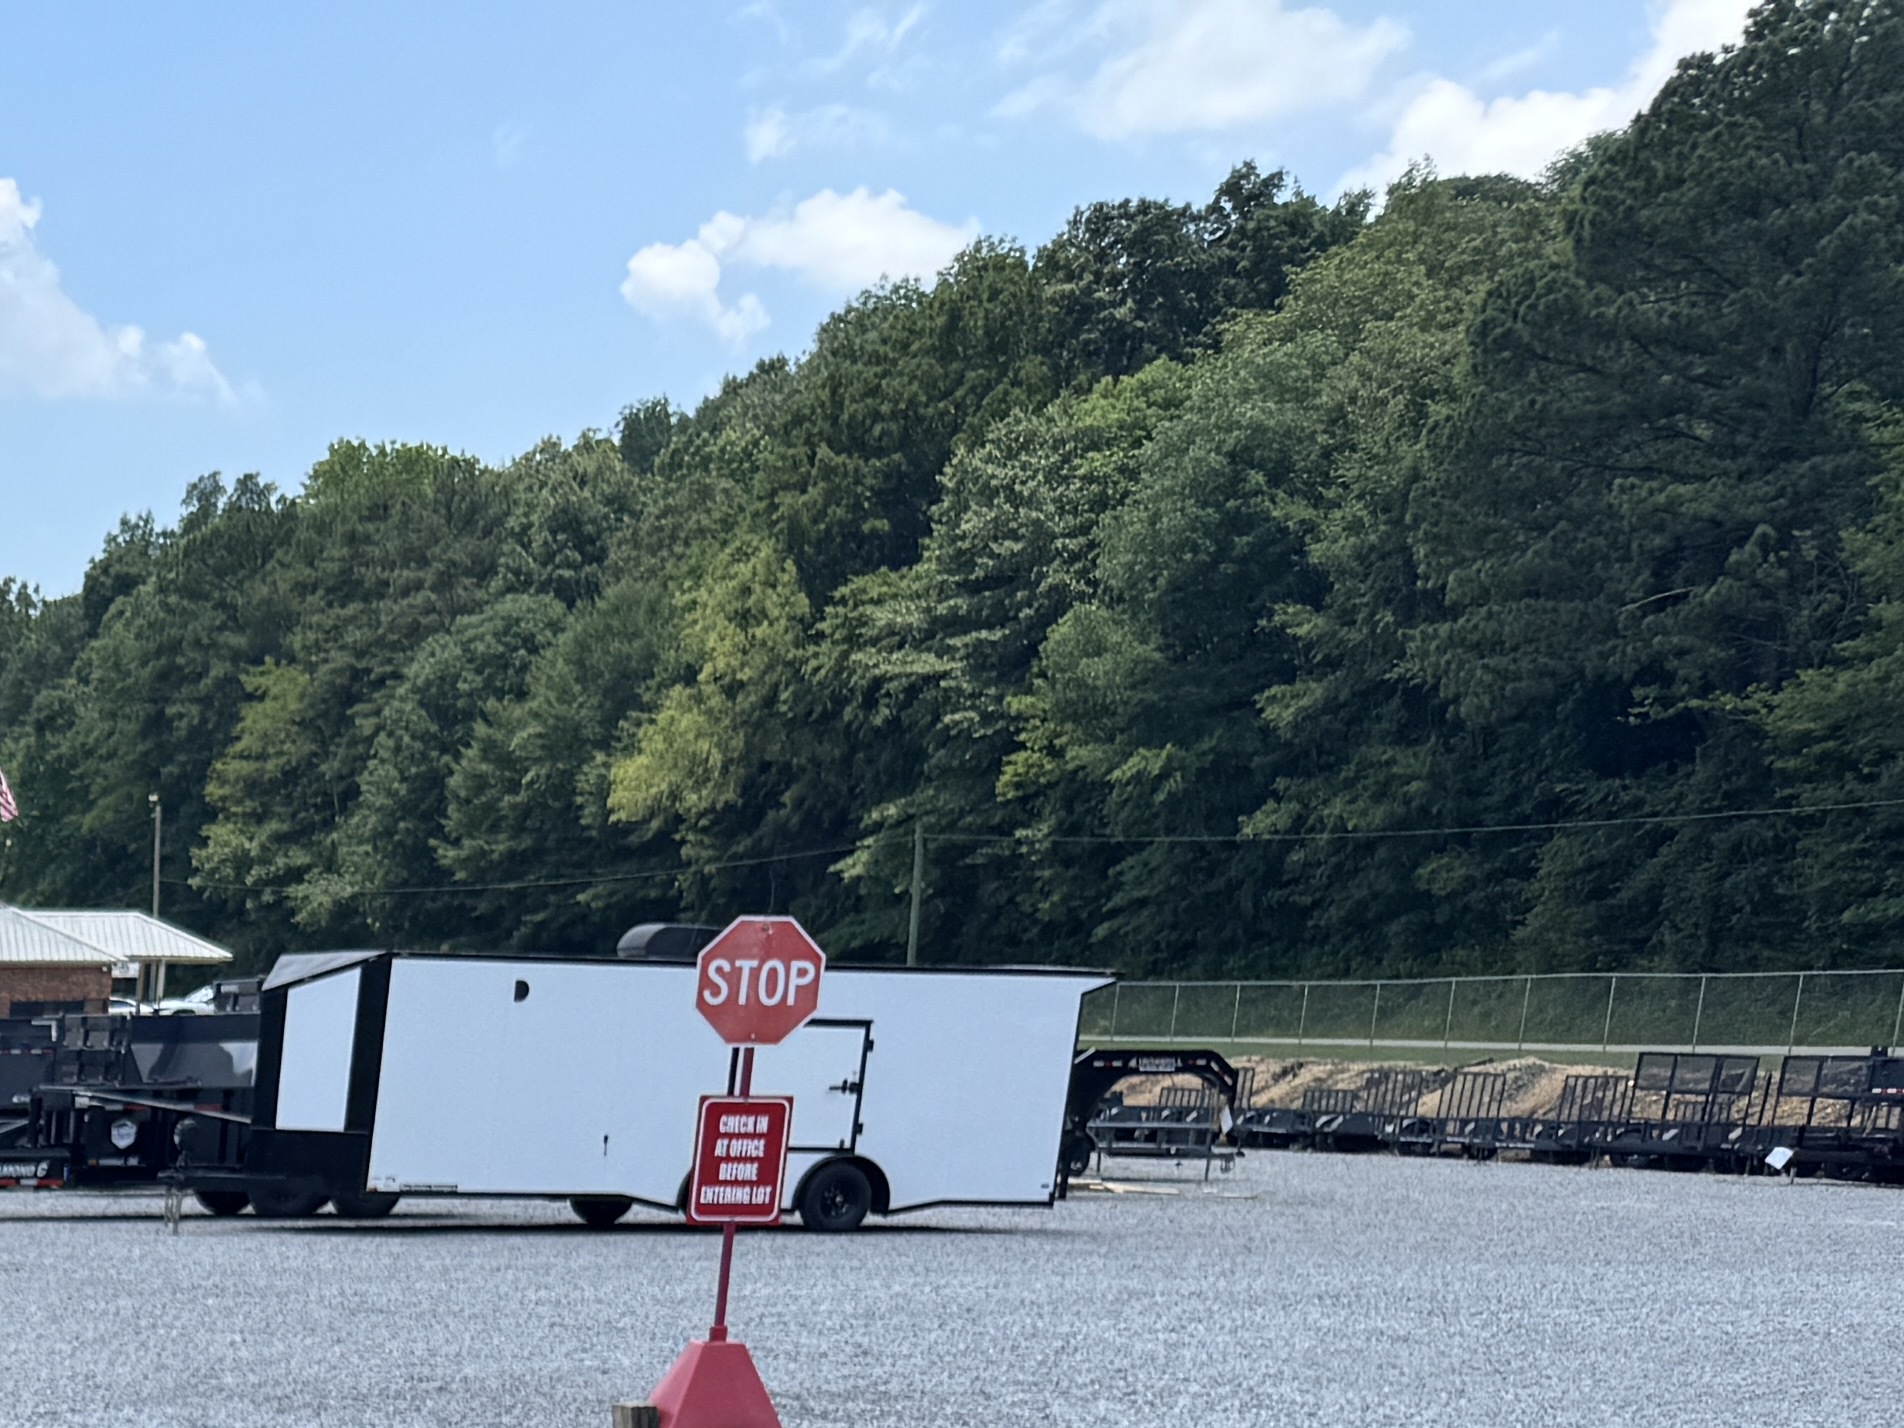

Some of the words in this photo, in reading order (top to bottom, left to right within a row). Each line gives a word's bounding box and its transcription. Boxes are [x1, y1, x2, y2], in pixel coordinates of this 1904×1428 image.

[703, 958, 816, 1007] STOP
[719, 1114, 756, 1134] CHECK
[756, 1114, 769, 1134] IN
[714, 1138, 729, 1157] AT
[729, 1138, 766, 1157] OFFICE
[719, 1162, 759, 1181] BEFORE
[699, 1185, 751, 1205] ENTERING
[751, 1185, 772, 1205] LOT
